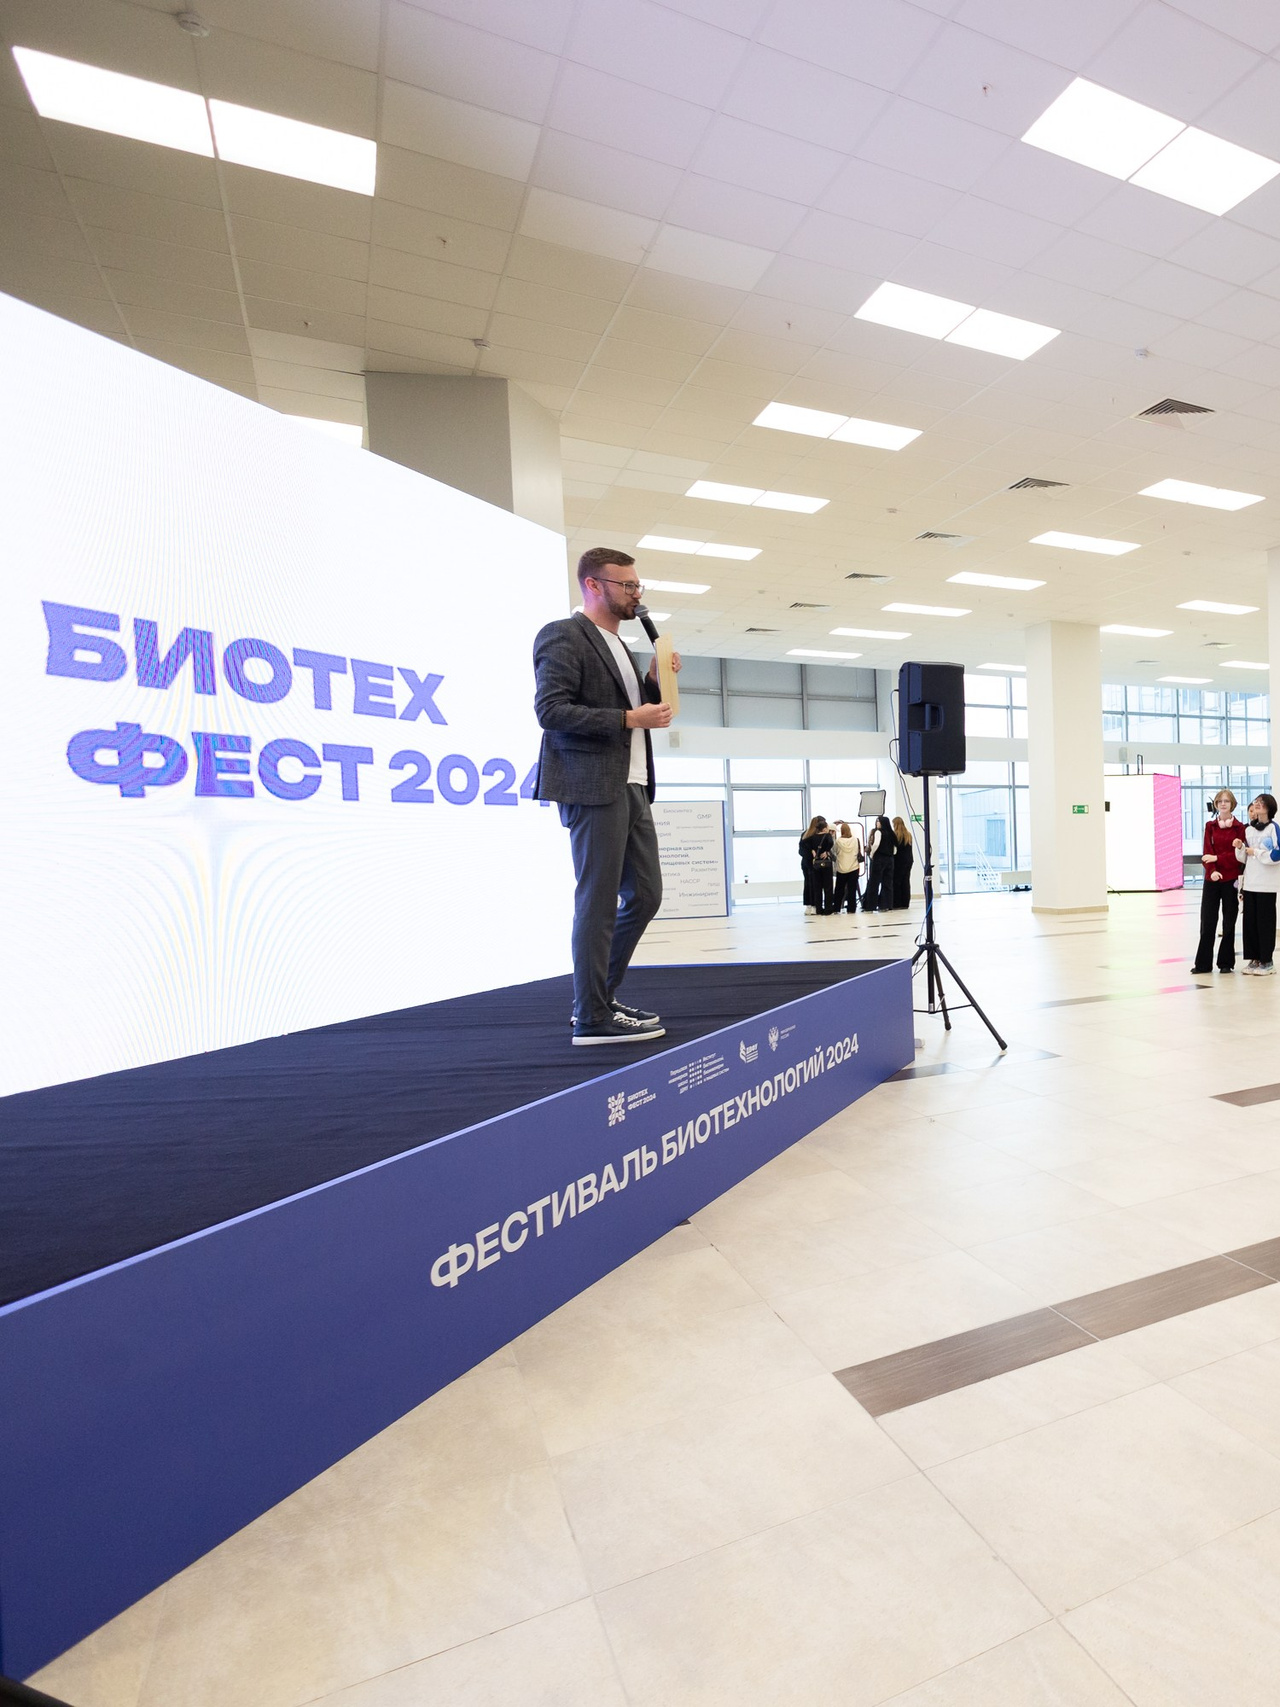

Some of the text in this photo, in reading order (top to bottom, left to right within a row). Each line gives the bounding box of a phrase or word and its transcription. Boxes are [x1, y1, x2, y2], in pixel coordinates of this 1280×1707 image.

[42, 601, 448, 726] БИОТЕХ
[66, 722, 375, 802] ФЕСТ
[430, 1033, 859, 1289] ФЕСТИВАЛЬ БИОТЕХНОЛОГИЙ 2024
